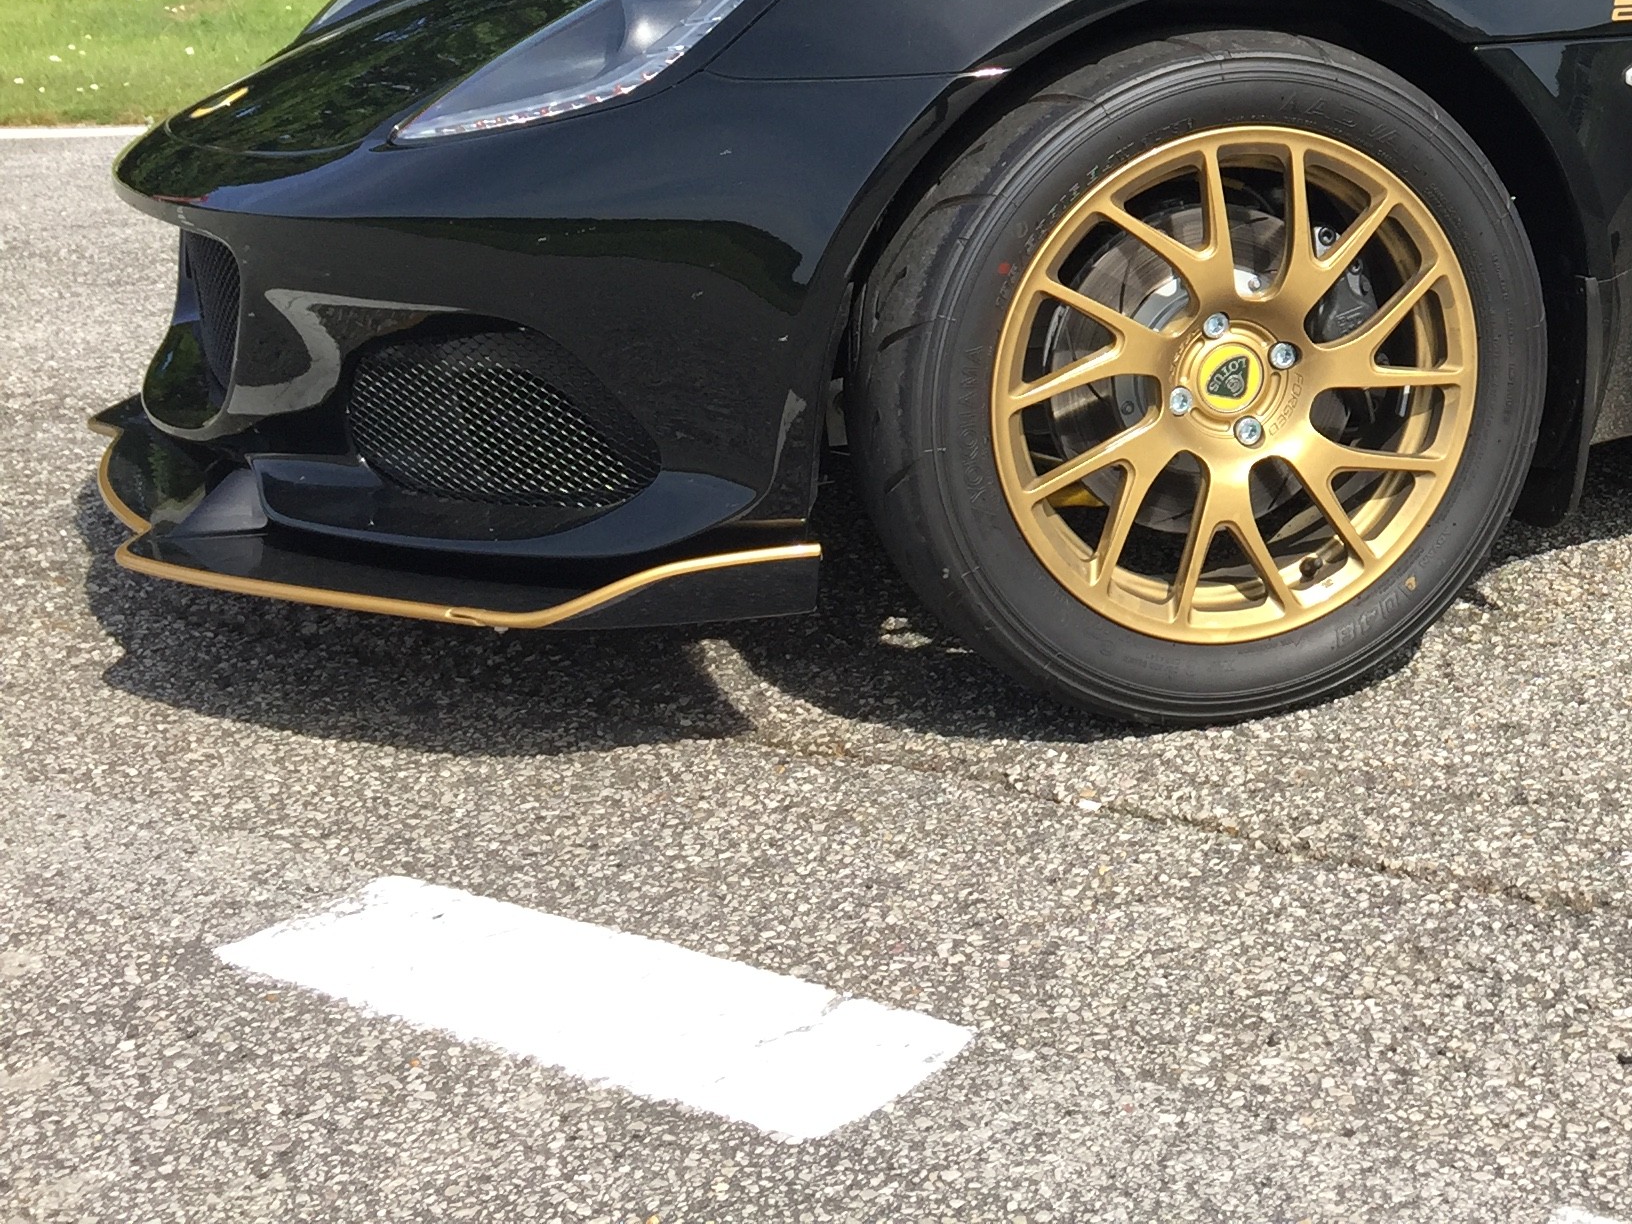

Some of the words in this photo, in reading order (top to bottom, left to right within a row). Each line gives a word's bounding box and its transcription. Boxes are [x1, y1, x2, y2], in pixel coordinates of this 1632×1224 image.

[1208, 357, 1248, 393] LOTUS
[1268, 372, 1304, 437] FORGED
[958, 344, 986, 504] YOKOHAMA
